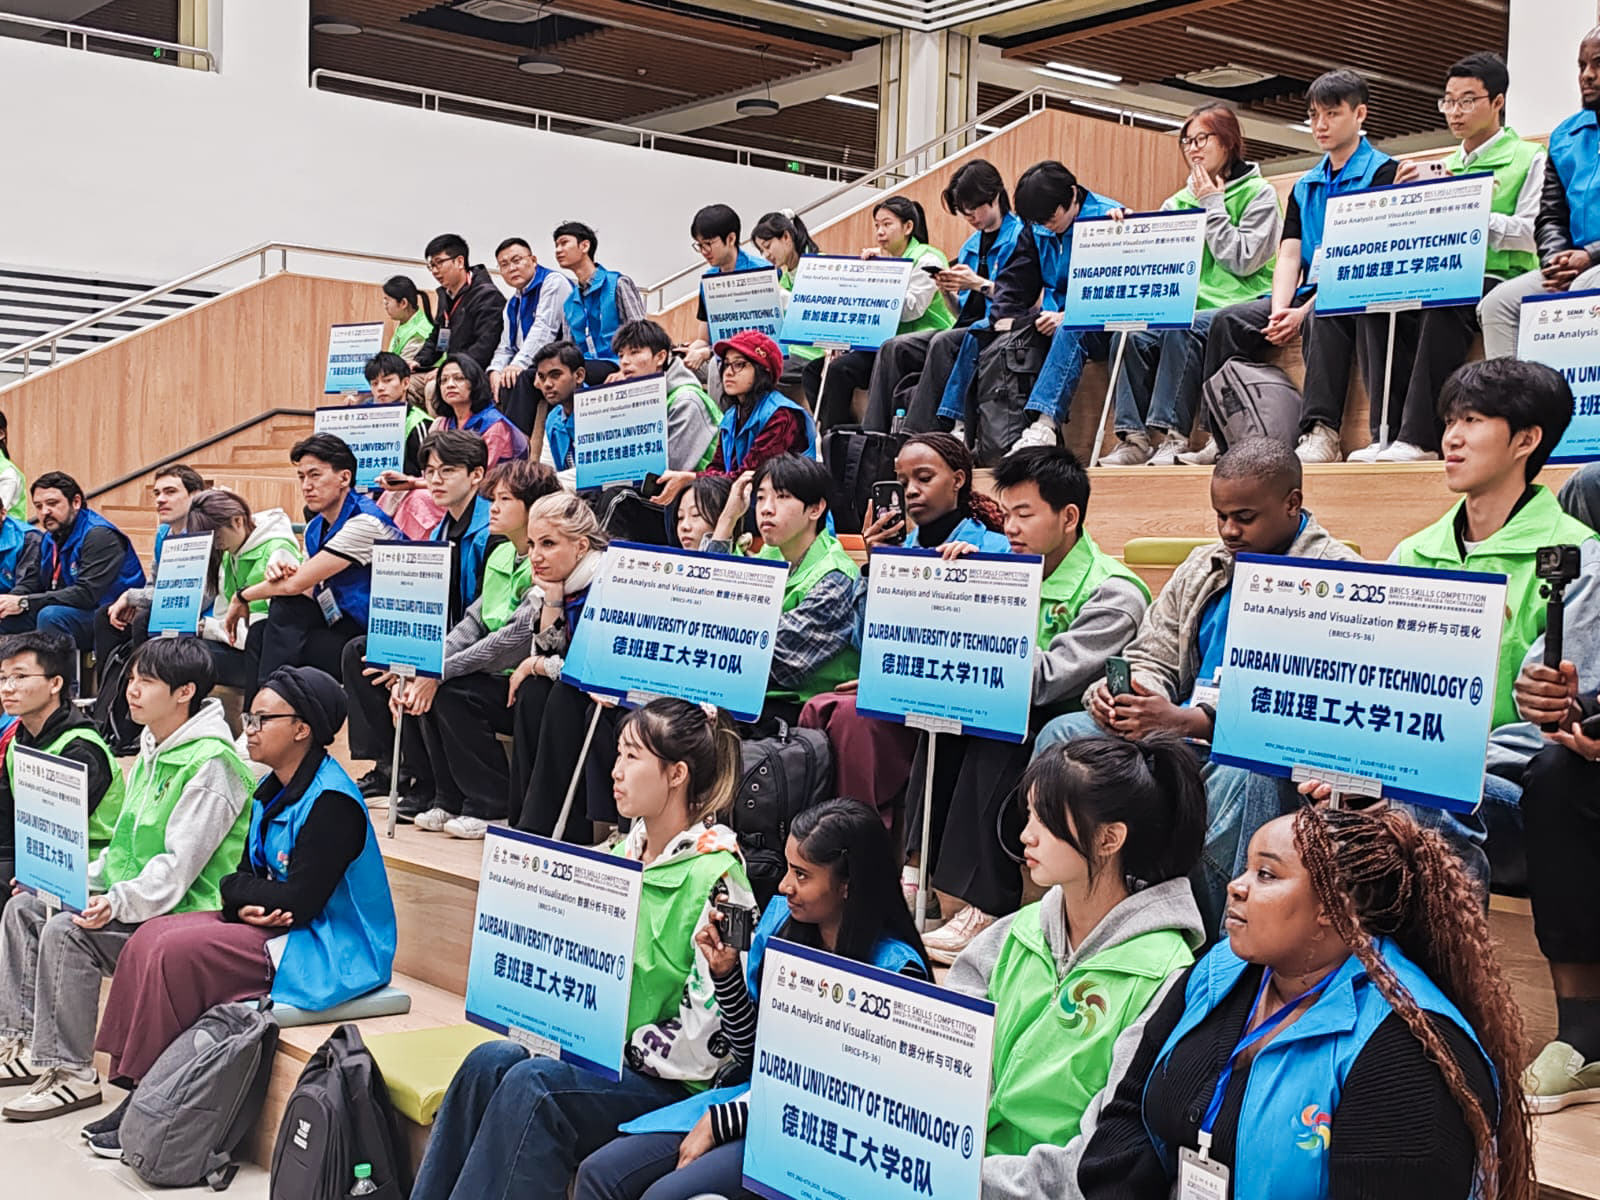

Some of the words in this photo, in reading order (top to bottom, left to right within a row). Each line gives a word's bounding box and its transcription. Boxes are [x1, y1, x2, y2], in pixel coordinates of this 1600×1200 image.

[1400, 192, 1423, 204] 2025
[1326, 241, 1388, 259] SINGAPORE
[1390, 232, 1467, 252] POLYTECHNIC
[1073, 266, 1122, 279] SINGAPORE
[1124, 262, 1185, 276] POLYTECHNIC
[1337, 253, 1462, 281] 新加坡理工学院4队
[793, 294, 836, 305] SINGAPORE
[838, 297, 890, 308] POLYTECHNIC
[1081, 282, 1180, 300] 新加坡理工学院3队
[739, 309, 774, 320] POLYTECHNIC
[802, 310, 880, 326] 新加坡理工学院1队
[1534, 332, 1555, 341] Data
[1558, 328, 1598, 339] Analysis
[578, 433, 595, 445] SISTER
[596, 429, 621, 442] NIVEDITA
[622, 423, 656, 437] UNIVERSITY
[686, 564, 711, 580] 2025
[944, 568, 968, 583] 2025
[612, 576, 627, 584] Data
[629, 578, 655, 589] Analysis
[657, 582, 670, 590] and
[672, 584, 714, 596] Visualization
[877, 586, 890, 594] Data
[892, 587, 917, 598] Analysis
[918, 589, 930, 597] and
[932, 591, 972, 601] Visualization
[1349, 584, 1386, 604] 2025
[1390, 586, 1409, 595] BRICS
[1411, 589, 1435, 598] SKILLS
[1436, 591, 1486, 602] COMPETITION
[600, 608, 636, 626] DURBAN
[637, 613, 687, 636] UNIVERSITY
[688, 622, 700, 637] OF
[701, 623, 759, 646] TECHNOLOGY
[1244, 603, 1264, 613] Data
[1267, 605, 1305, 618] Analysis
[1308, 610, 1327, 620] and
[1330, 612, 1393, 628] Visualization
[1396, 618, 1481, 638] 数据分析与可视化
[869, 622, 901, 642] DURBAN
[903, 626, 949, 647] UNIVERSITY
[951, 631, 961, 649] OF
[963, 632, 1018, 655] TECHNOLOGY
[612, 636, 743, 675] 德班理工大学10队
[882, 653, 1004, 689] 德班理工大学11队
[1230, 648, 1281, 673] DURBAN
[1283, 655, 1357, 684] UNIVERSITY
[1359, 664, 1376, 687] OF
[1379, 667, 1468, 700] TECHNOLOGY
[1251, 686, 1445, 743] 德班理工大学12队
[551, 861, 573, 882] 2025
[489, 871, 501, 882] Data
[503, 874, 525, 890] Analysis
[527, 882, 538, 893] and
[539, 884, 576, 904] Visualization
[479, 913, 509, 939] DURBAN
[510, 922, 553, 952] UNIVERSITY
[554, 937, 564, 956] OF
[565, 939, 616, 975] TECHNOLOGY
[494, 952, 597, 1011] 德班理工大学7队
[860, 992, 891, 1019] 2025
[894, 1001, 910, 1012] BRICS
[912, 1006, 932, 1020] SKILLS
[934, 1013, 976, 1034] COMPETITION
[772, 998, 789, 1013] Data
[791, 1005, 823, 1024] Analysis
[825, 1018, 841, 1030] and
[843, 1022, 896, 1050] Visualization
[899, 1040, 972, 1078] 数据分析与可视化
[760, 1050, 801, 1090] DURBAN
[802, 1065, 865, 1112] UNIVERSITY
[866, 1091, 881, 1118] OF
[882, 1095, 960, 1150] TECHNOLOGY
[782, 1102, 934, 1197] 德班理工大学8队
